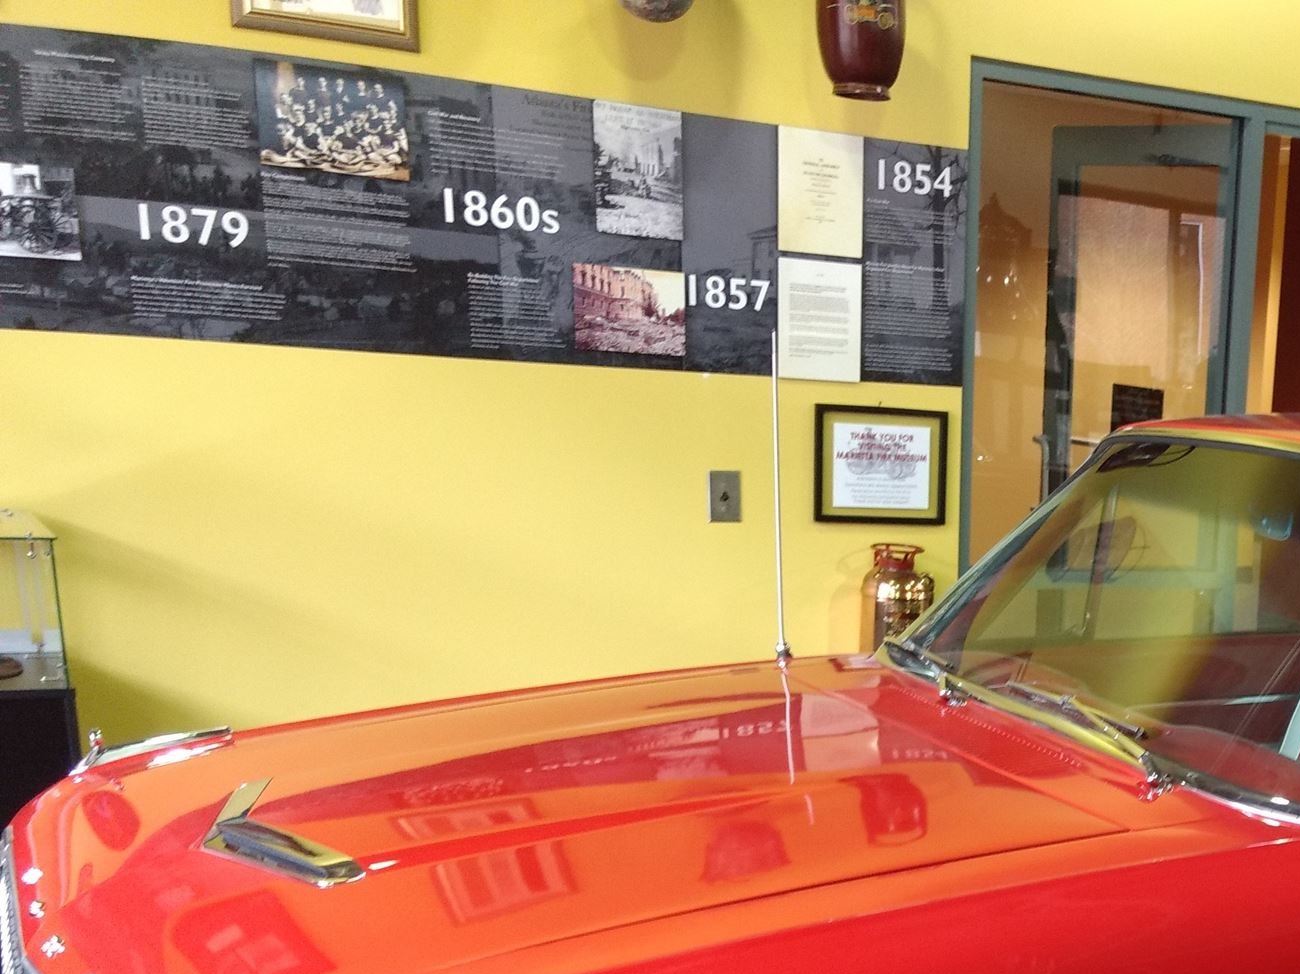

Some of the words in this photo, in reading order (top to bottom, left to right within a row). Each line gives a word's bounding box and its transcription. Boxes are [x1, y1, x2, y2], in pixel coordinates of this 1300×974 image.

[877, 158, 954, 198] 1854
[138, 203, 249, 249] 1879
[442, 187, 561, 235] 1860s
[687, 273, 771, 313] 1857
